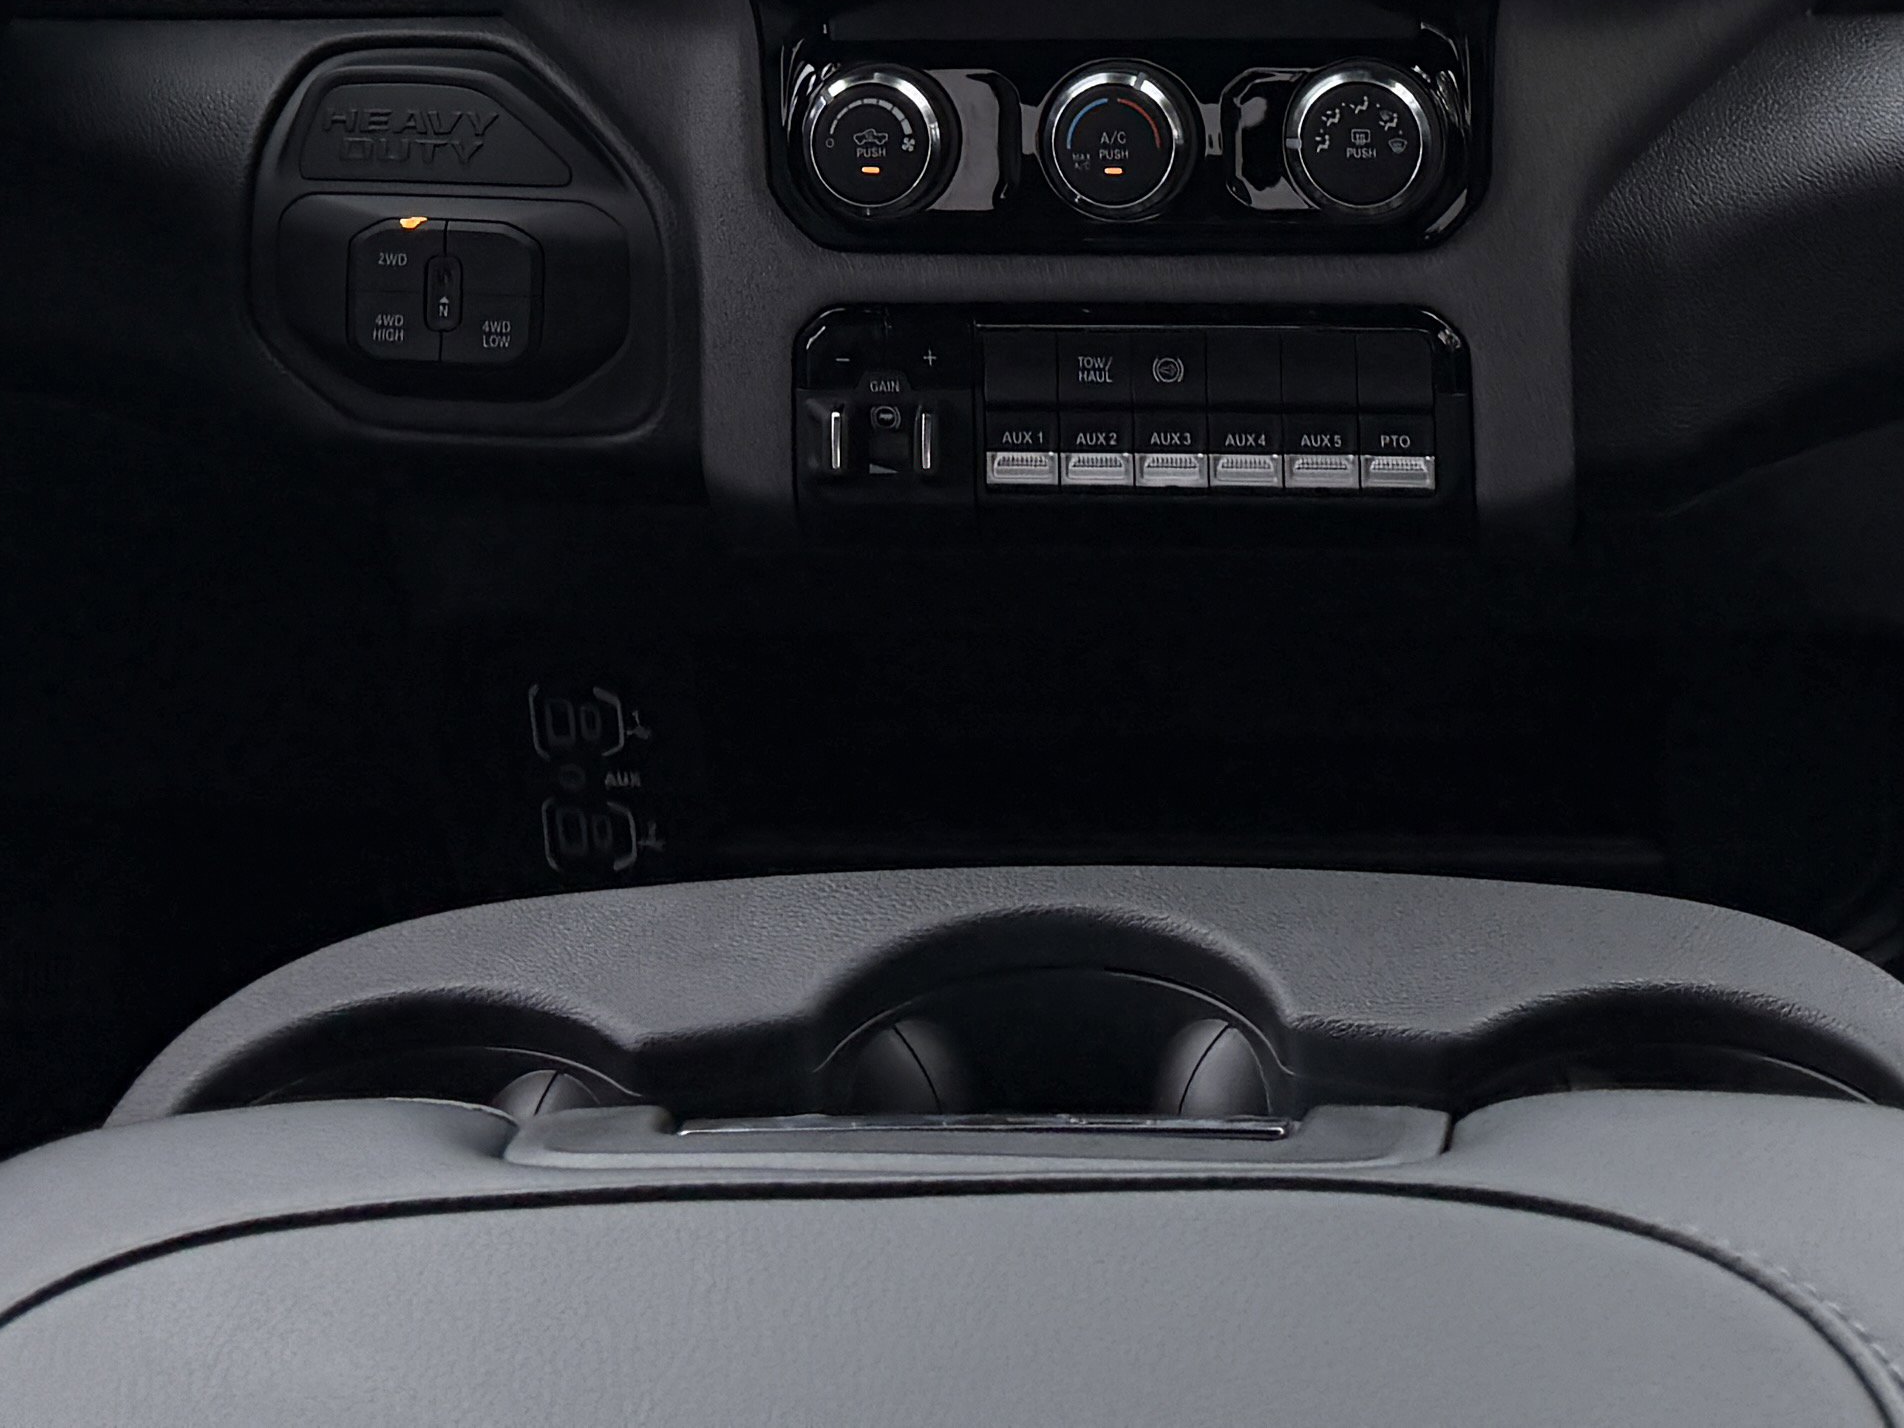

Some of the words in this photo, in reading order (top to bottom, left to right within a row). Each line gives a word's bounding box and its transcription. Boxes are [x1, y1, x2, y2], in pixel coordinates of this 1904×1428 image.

[323, 106, 501, 137] HEAVY
[1100, 131, 1127, 145] A/C
[338, 136, 485, 165] DUTY
[856, 147, 887, 159] PUSH
[1098, 148, 1129, 160] PUSH
[1345, 146, 1378, 159] PUSH
[377, 252, 408, 267] 2WD
[439, 302, 449, 318] N
[374, 313, 405, 328] 4WD
[482, 319, 512, 335] 4WD
[372, 327, 405, 343] HIGH
[482, 334, 512, 349] LOW
[1078, 370, 1113, 384] HAUL
[869, 380, 900, 393] GAIN
[1002, 430, 1033, 445] AUX
[1037, 430, 1044, 444] 1
[1075, 431, 1107, 445] AUX
[1109, 431, 1118, 445] 2
[1149, 432, 1182, 446] AUX
[1183, 432, 1192, 446] 3
[1224, 433, 1257, 447] AUX
[1257, 433, 1267, 447] 4
[1300, 433, 1333, 447] AUX
[1333, 433, 1343, 447] 5
[1379, 434, 1412, 449] PTO
